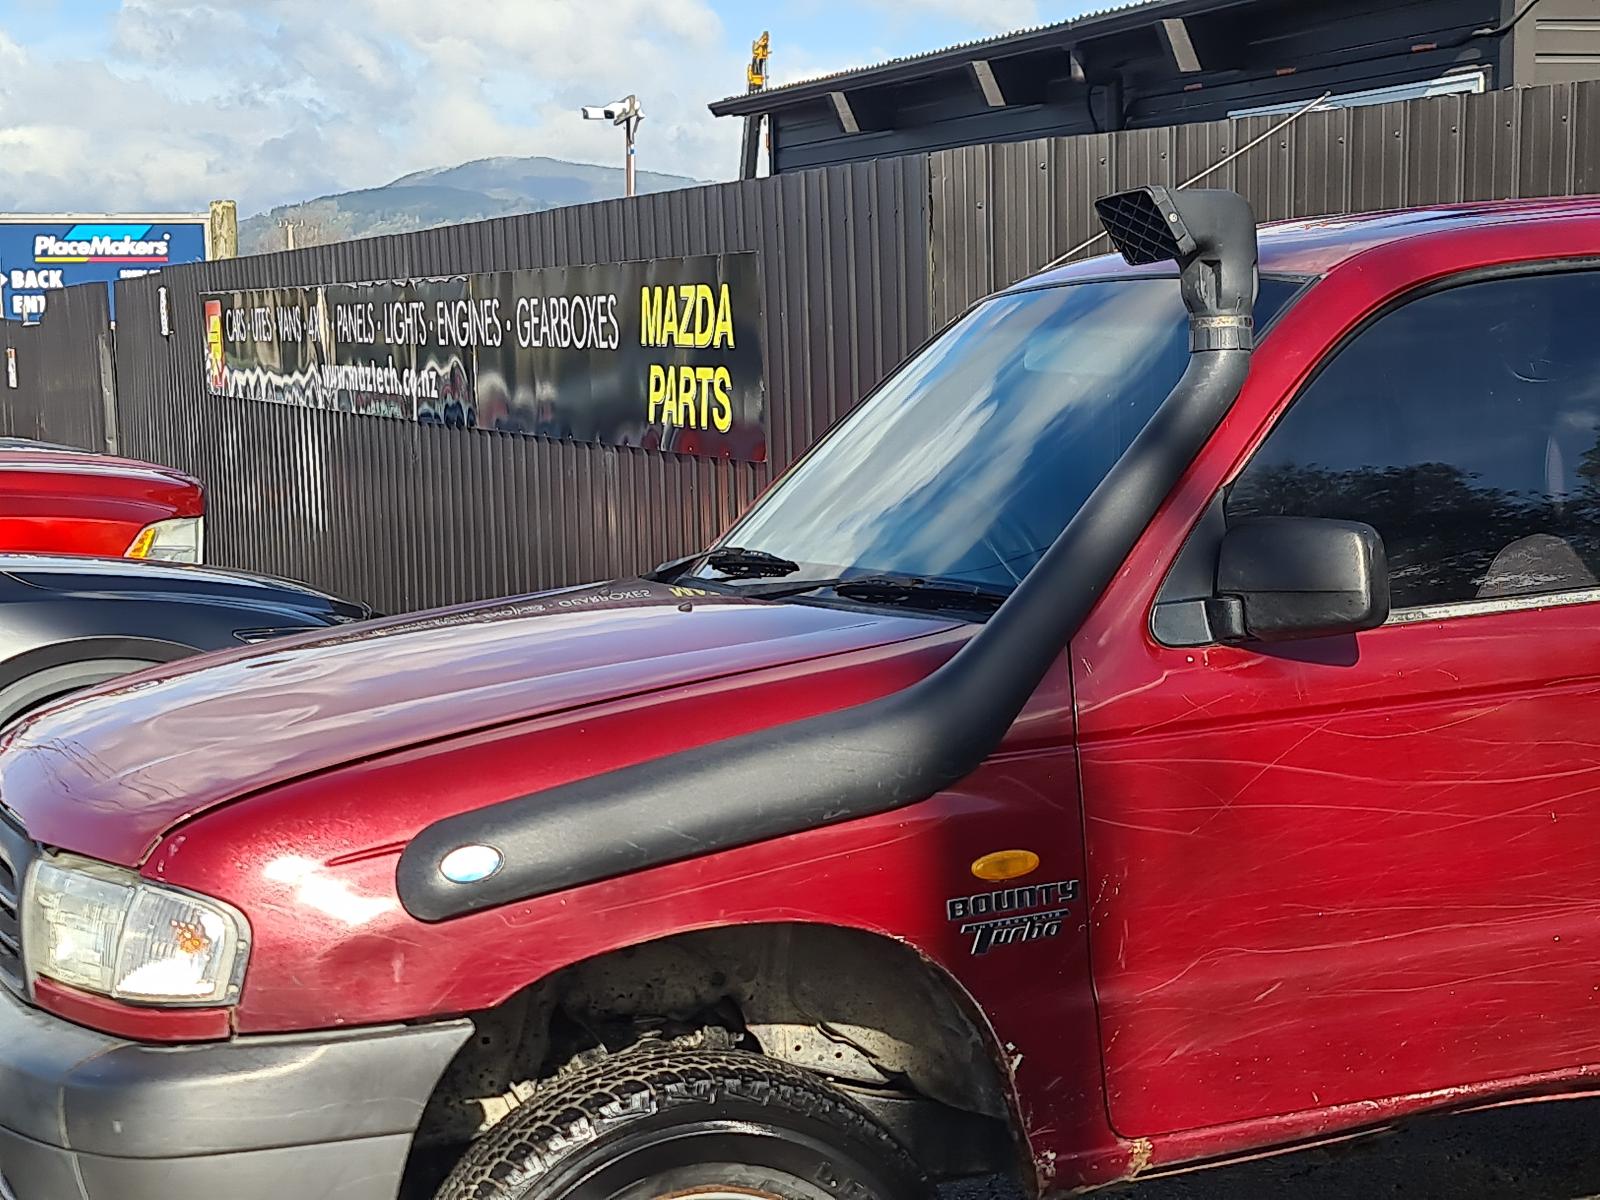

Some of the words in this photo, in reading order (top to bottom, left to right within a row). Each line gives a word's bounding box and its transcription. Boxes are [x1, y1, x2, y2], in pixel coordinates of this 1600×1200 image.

[35, 235, 168, 256] PlaceMakers
[11, 269, 63, 289] BACK
[225, 308, 246, 342] CARS
[251, 306, 273, 342] UTES
[277, 305, 302, 342] VANS
[337, 302, 375, 344] PANELS
[384, 302, 427, 346] LIGHTS
[437, 299, 502, 347] ENGINES
[517, 294, 620, 350] GEARBOXES
[640, 283, 734, 348] MAZDA
[648, 364, 733, 433] PARTS
[946, 879, 1079, 921] BOUNTY
[960, 908, 1070, 955] Turbo
